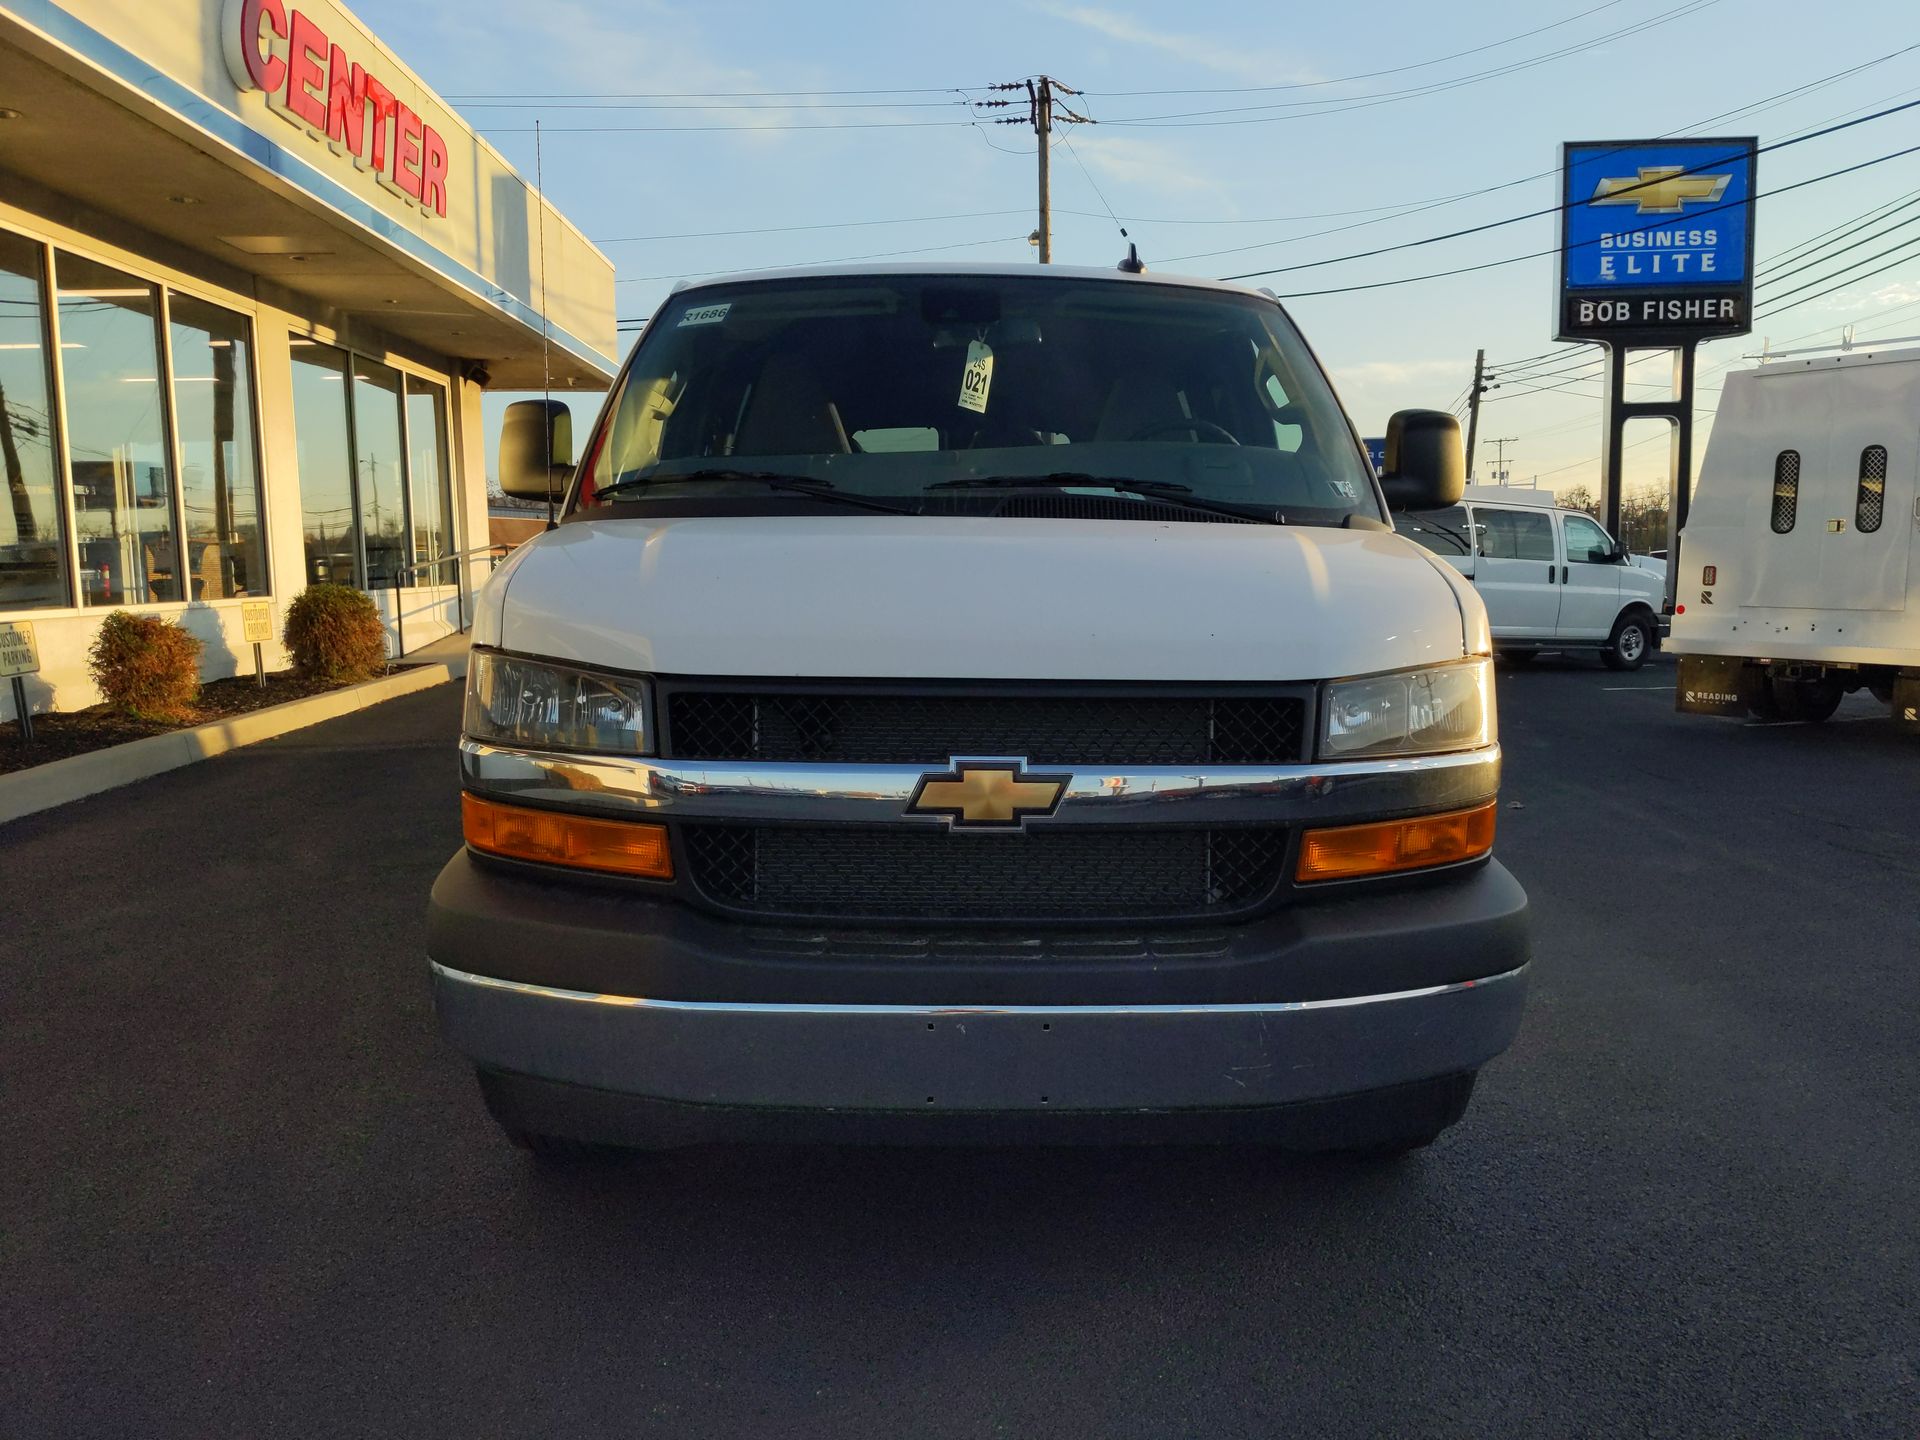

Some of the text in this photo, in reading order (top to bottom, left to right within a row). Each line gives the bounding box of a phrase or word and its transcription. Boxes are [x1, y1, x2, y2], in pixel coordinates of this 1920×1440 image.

[240, 0, 449, 218] CENTER
[1600, 230, 1718, 249] BUSINESS
[1600, 253, 1717, 275] ELITE
[683, 308, 727, 321] R1686
[1579, 299, 1735, 322] BOB FISHER
[965, 369, 987, 395] 021
[0, 630, 33, 649] USTOMER
[2, 648, 33, 667] PARKING
[1697, 691, 1738, 702] READING
